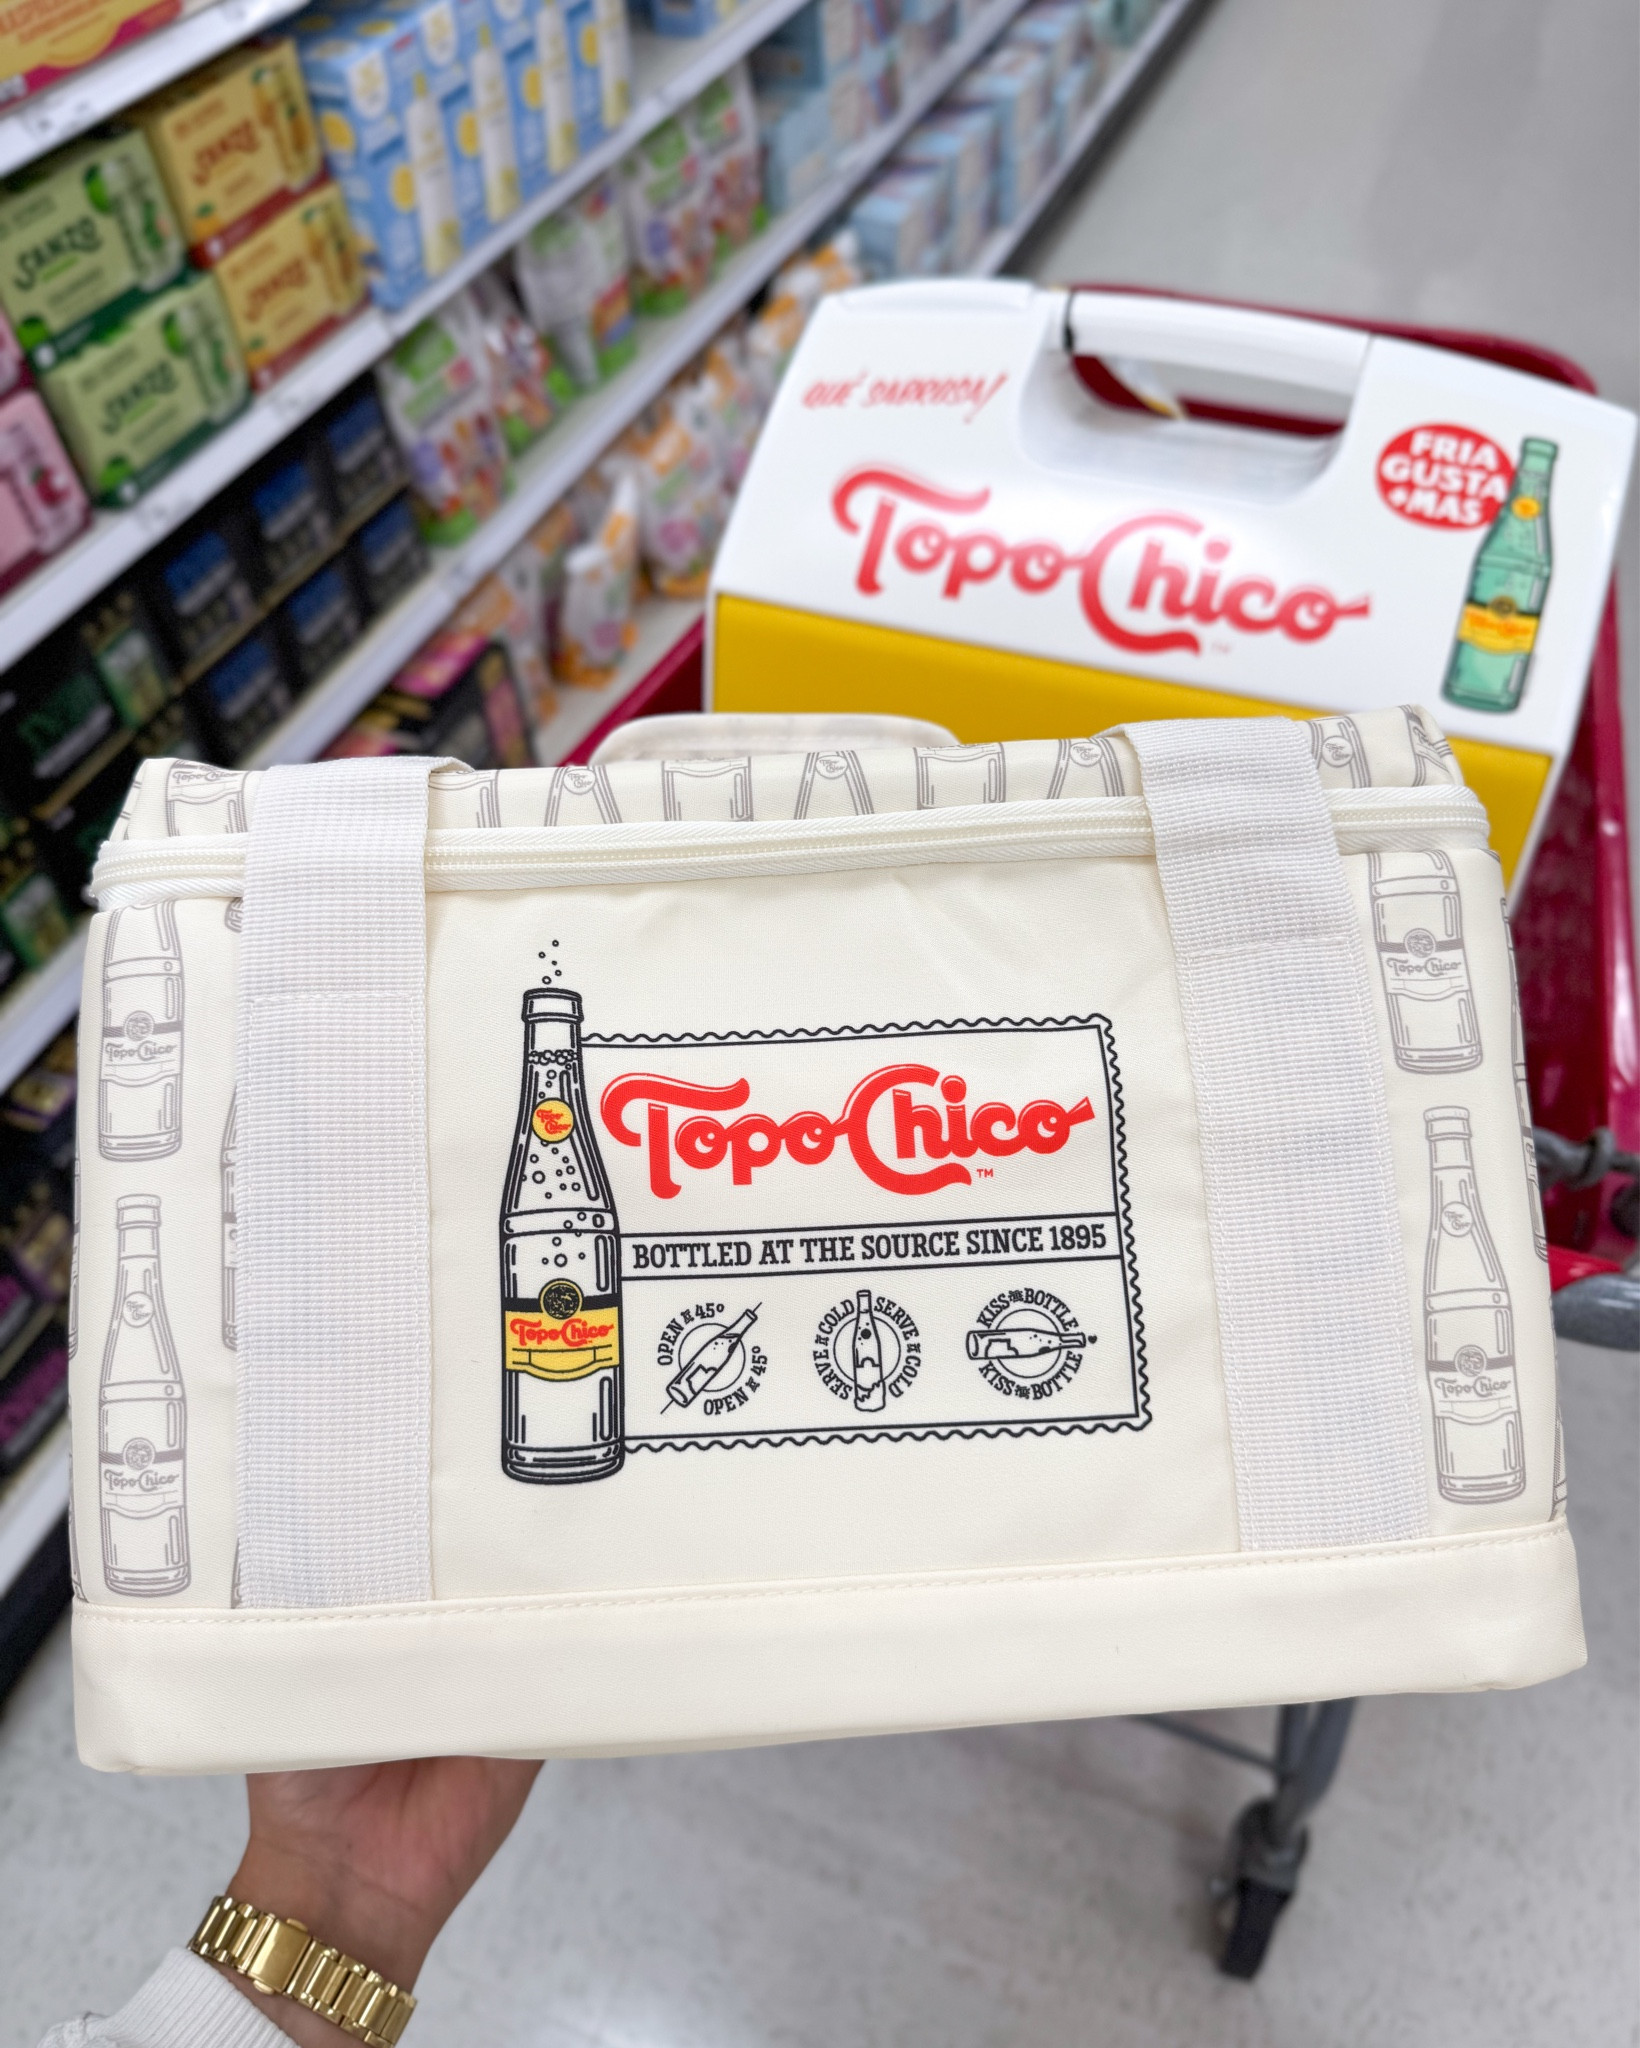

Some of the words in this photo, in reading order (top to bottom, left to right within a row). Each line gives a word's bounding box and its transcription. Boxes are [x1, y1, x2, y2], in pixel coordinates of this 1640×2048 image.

[1410, 430, 1499, 471] FRIA
[1380, 454, 1507, 503] GUSTA
[832, 463, 1083, 598] Topo
[1080, 509, 1371, 657] Chico
[1386, 957, 1426, 977] Topo
[104, 1043, 141, 1062] Topo
[600, 1072, 848, 1199] Topo
[844, 1063, 1095, 1196] Chico
[633, 1241, 752, 1269] BOTTLED
[759, 1238, 794, 1265] AT
[800, 1235, 855, 1263] THE
[862, 1230, 961, 1261] SOURCE
[967, 1226, 1044, 1255] SINCE
[1050, 1223, 1107, 1251] 1895
[818, 1299, 855, 1335] COLD
[874, 1296, 920, 1341] SERVE
[976, 1293, 1011, 1329] KISS
[1023, 1287, 1079, 1332] BOTTLE
[510, 1317, 562, 1347] Topo
[559, 1317, 615, 1348] Chico
[657, 1318, 685, 1366] OPEN
[813, 1349, 853, 1400] SERVE
[888, 1355, 922, 1398] COLD
[978, 1360, 1016, 1396] KISS
[1030, 1350, 1083, 1401] BOTTLE
[1435, 1378, 1475, 1398] Topo
[703, 1386, 749, 1416] OPEN
[104, 1469, 141, 1491] Topo
[138, 1469, 180, 1492] Chico
